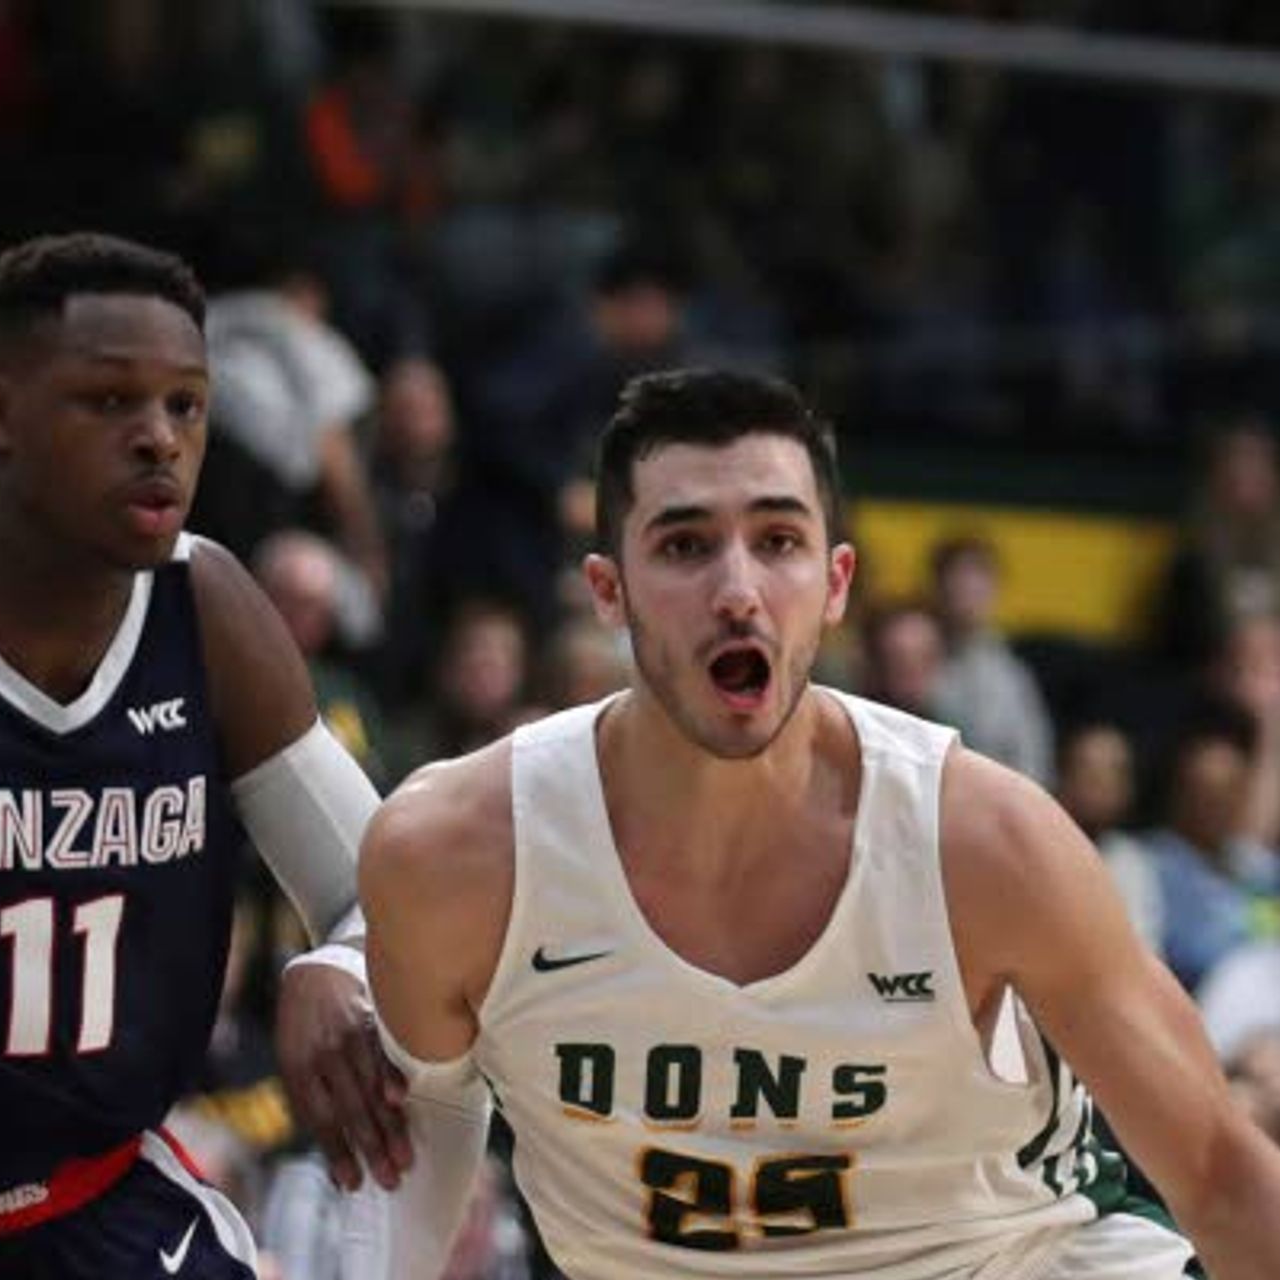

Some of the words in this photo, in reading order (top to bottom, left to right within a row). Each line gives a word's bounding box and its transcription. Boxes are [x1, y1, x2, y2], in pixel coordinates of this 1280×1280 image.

[127, 697, 187, 735] WCC
[867, 972, 937, 1003] WCC
[554, 1042, 889, 1130] DONS
[637, 1146, 858, 1252] 25
